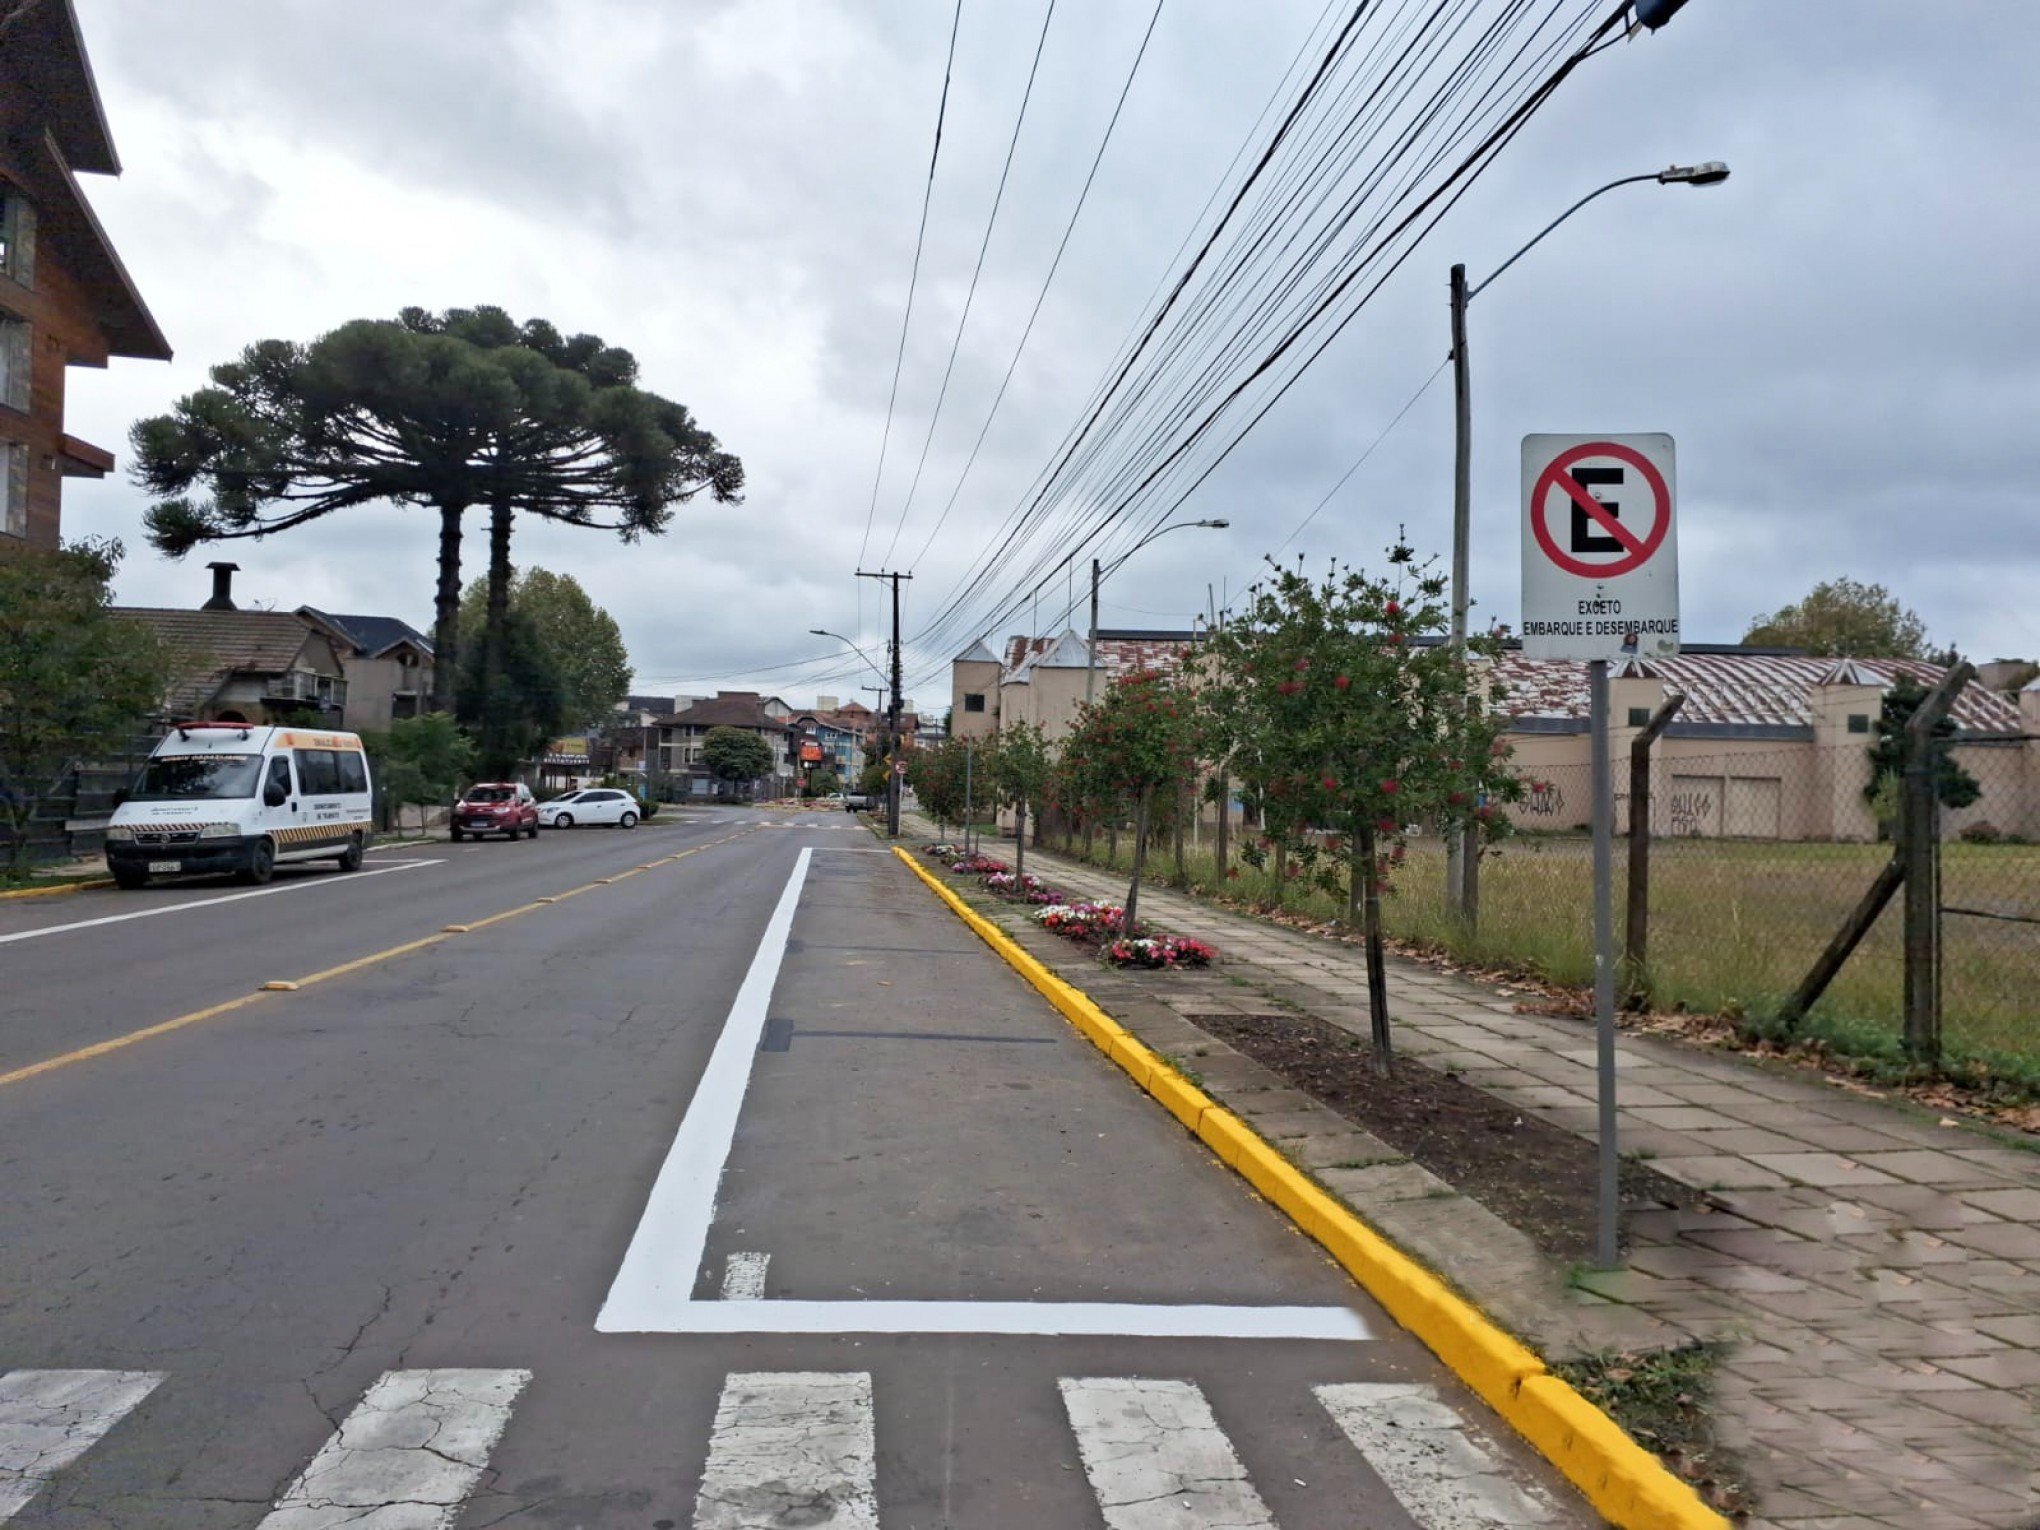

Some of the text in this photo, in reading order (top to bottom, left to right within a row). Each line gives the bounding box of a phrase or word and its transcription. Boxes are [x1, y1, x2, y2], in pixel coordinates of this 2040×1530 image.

[1571, 468, 1624, 553] E
[1578, 600, 1622, 615] EXCETO
[1523, 619, 1679, 636] EMBARQUE E DESEMBARQUE
